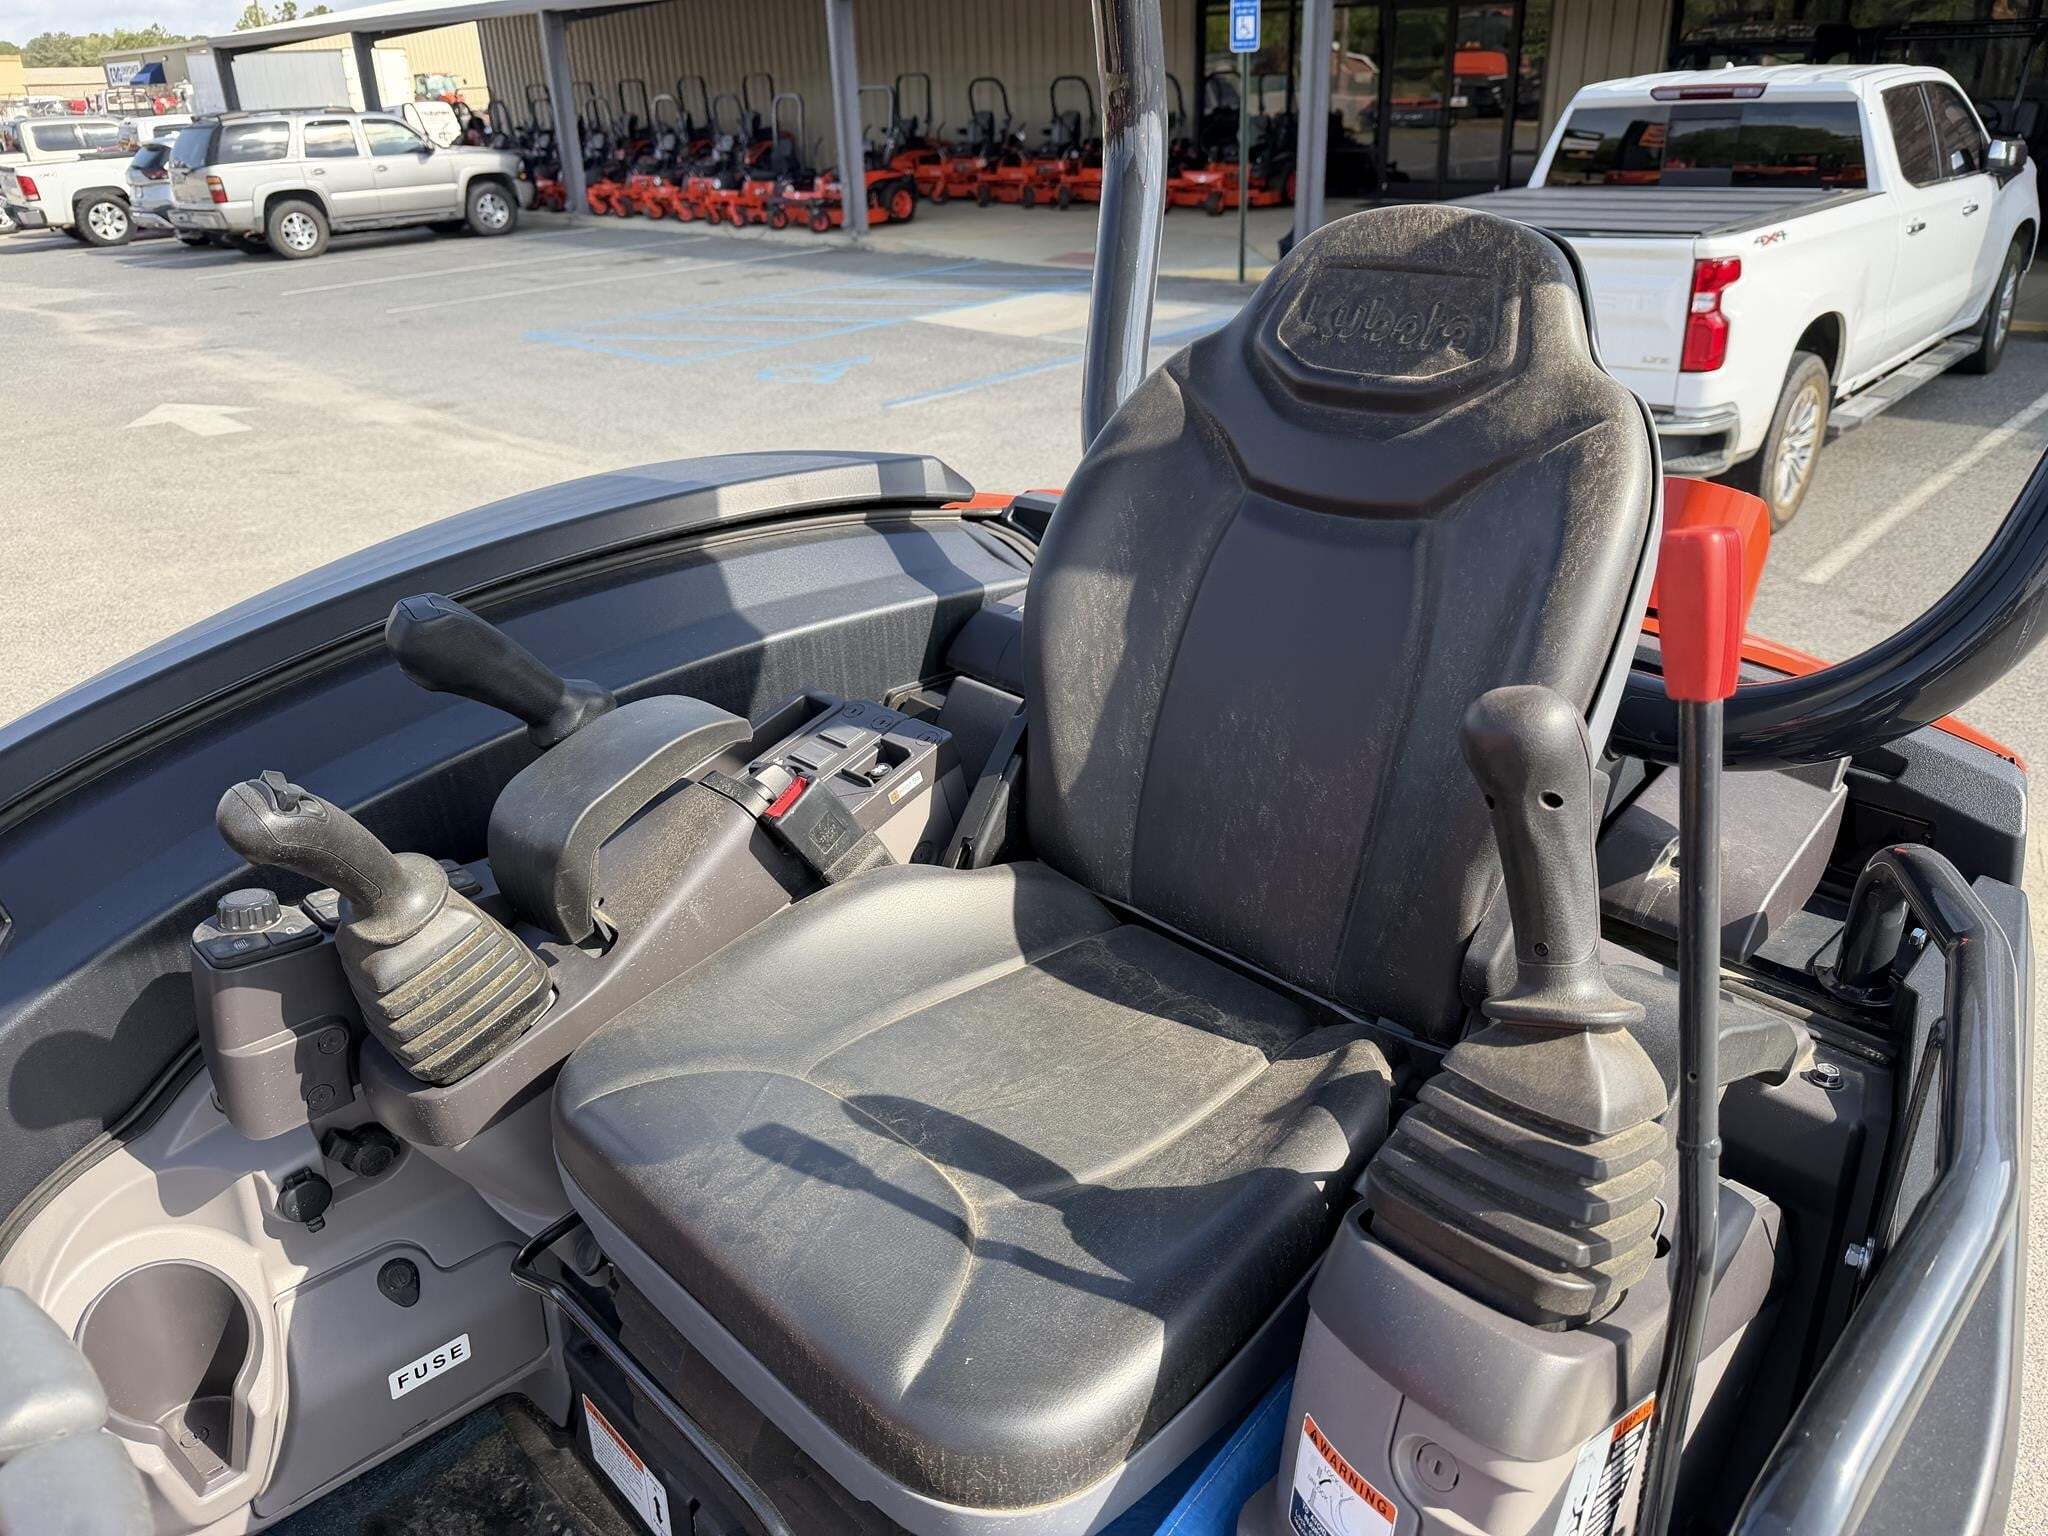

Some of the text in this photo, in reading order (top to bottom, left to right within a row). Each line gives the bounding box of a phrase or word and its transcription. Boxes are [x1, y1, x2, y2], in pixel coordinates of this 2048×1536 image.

[1304, 295, 1475, 352] Kubota
[397, 1343, 464, 1390] FUSE
[1320, 1439, 1388, 1515] WARNING
